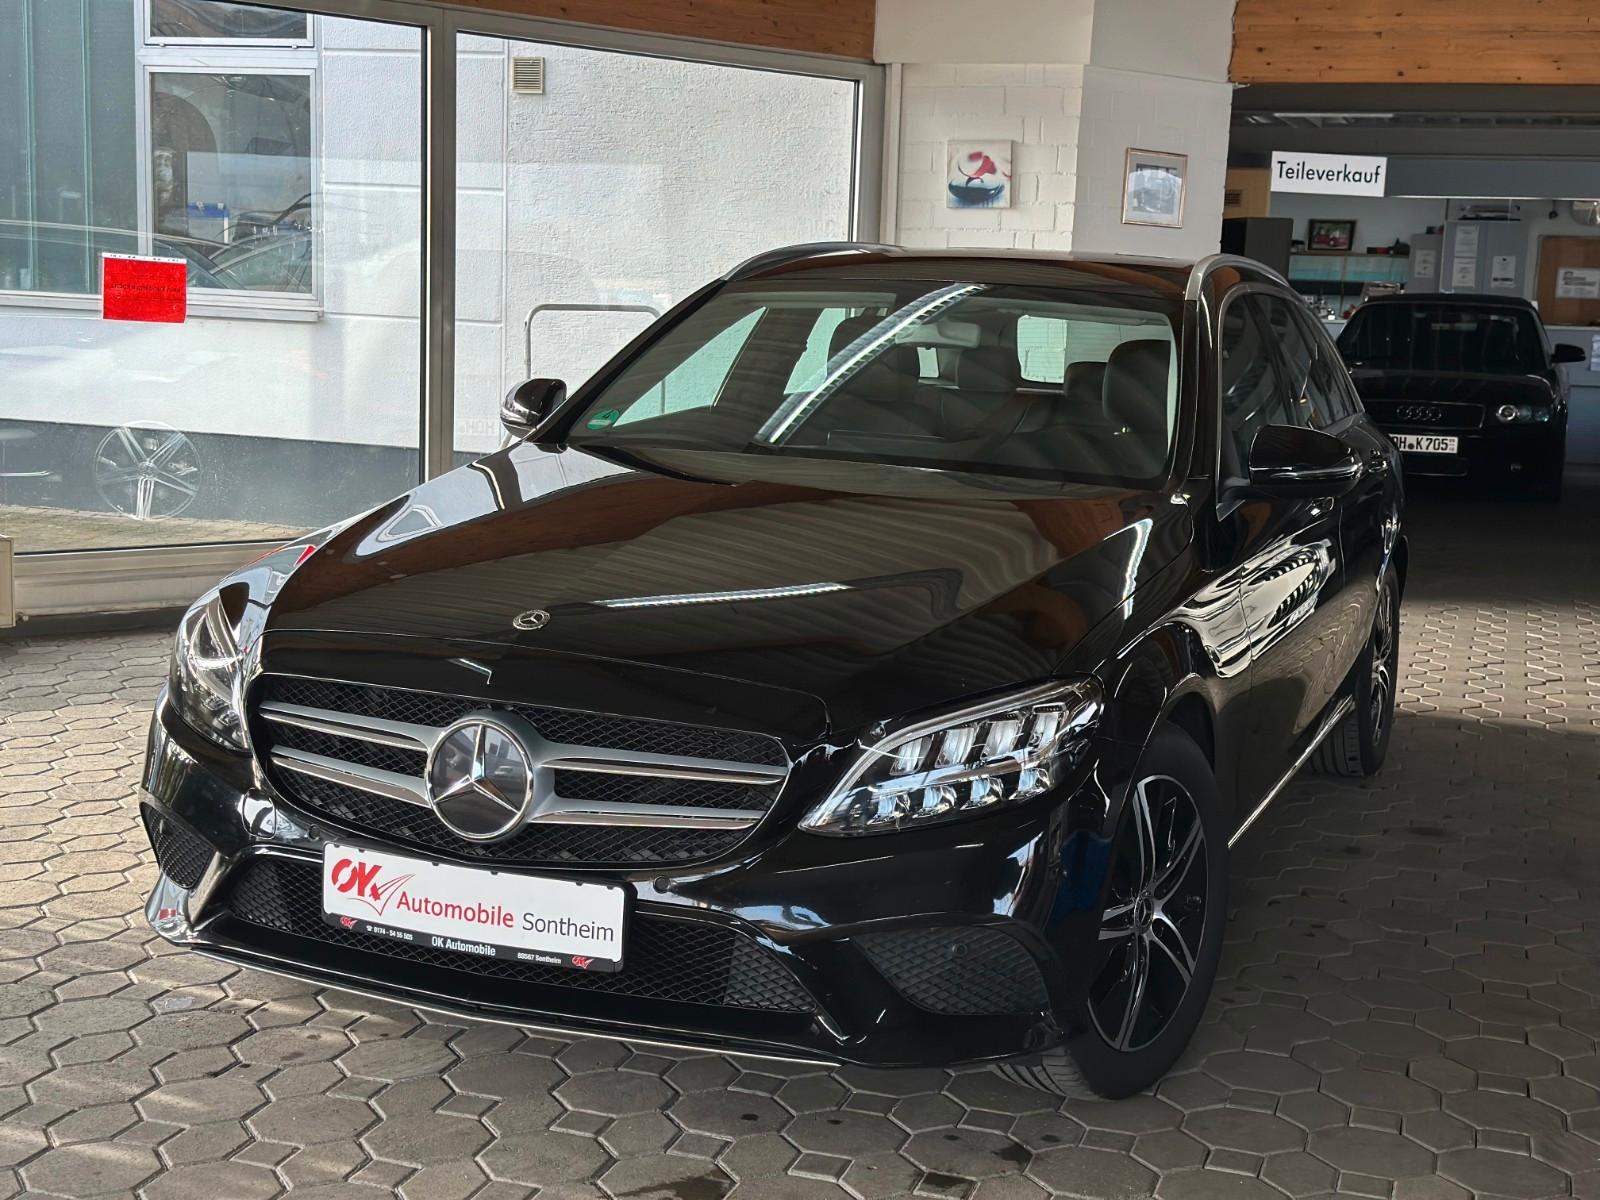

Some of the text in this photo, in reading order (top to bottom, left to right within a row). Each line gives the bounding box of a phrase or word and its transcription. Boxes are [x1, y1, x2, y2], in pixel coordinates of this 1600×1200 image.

[1277, 160, 1381, 184] Teileverkauf
[331, 858, 383, 902] OK
[396, 891, 614, 942] Automobile Sontheim
[431, 935, 496, 956] OK Automobile
[535, 954, 562, 965] Sontheim
